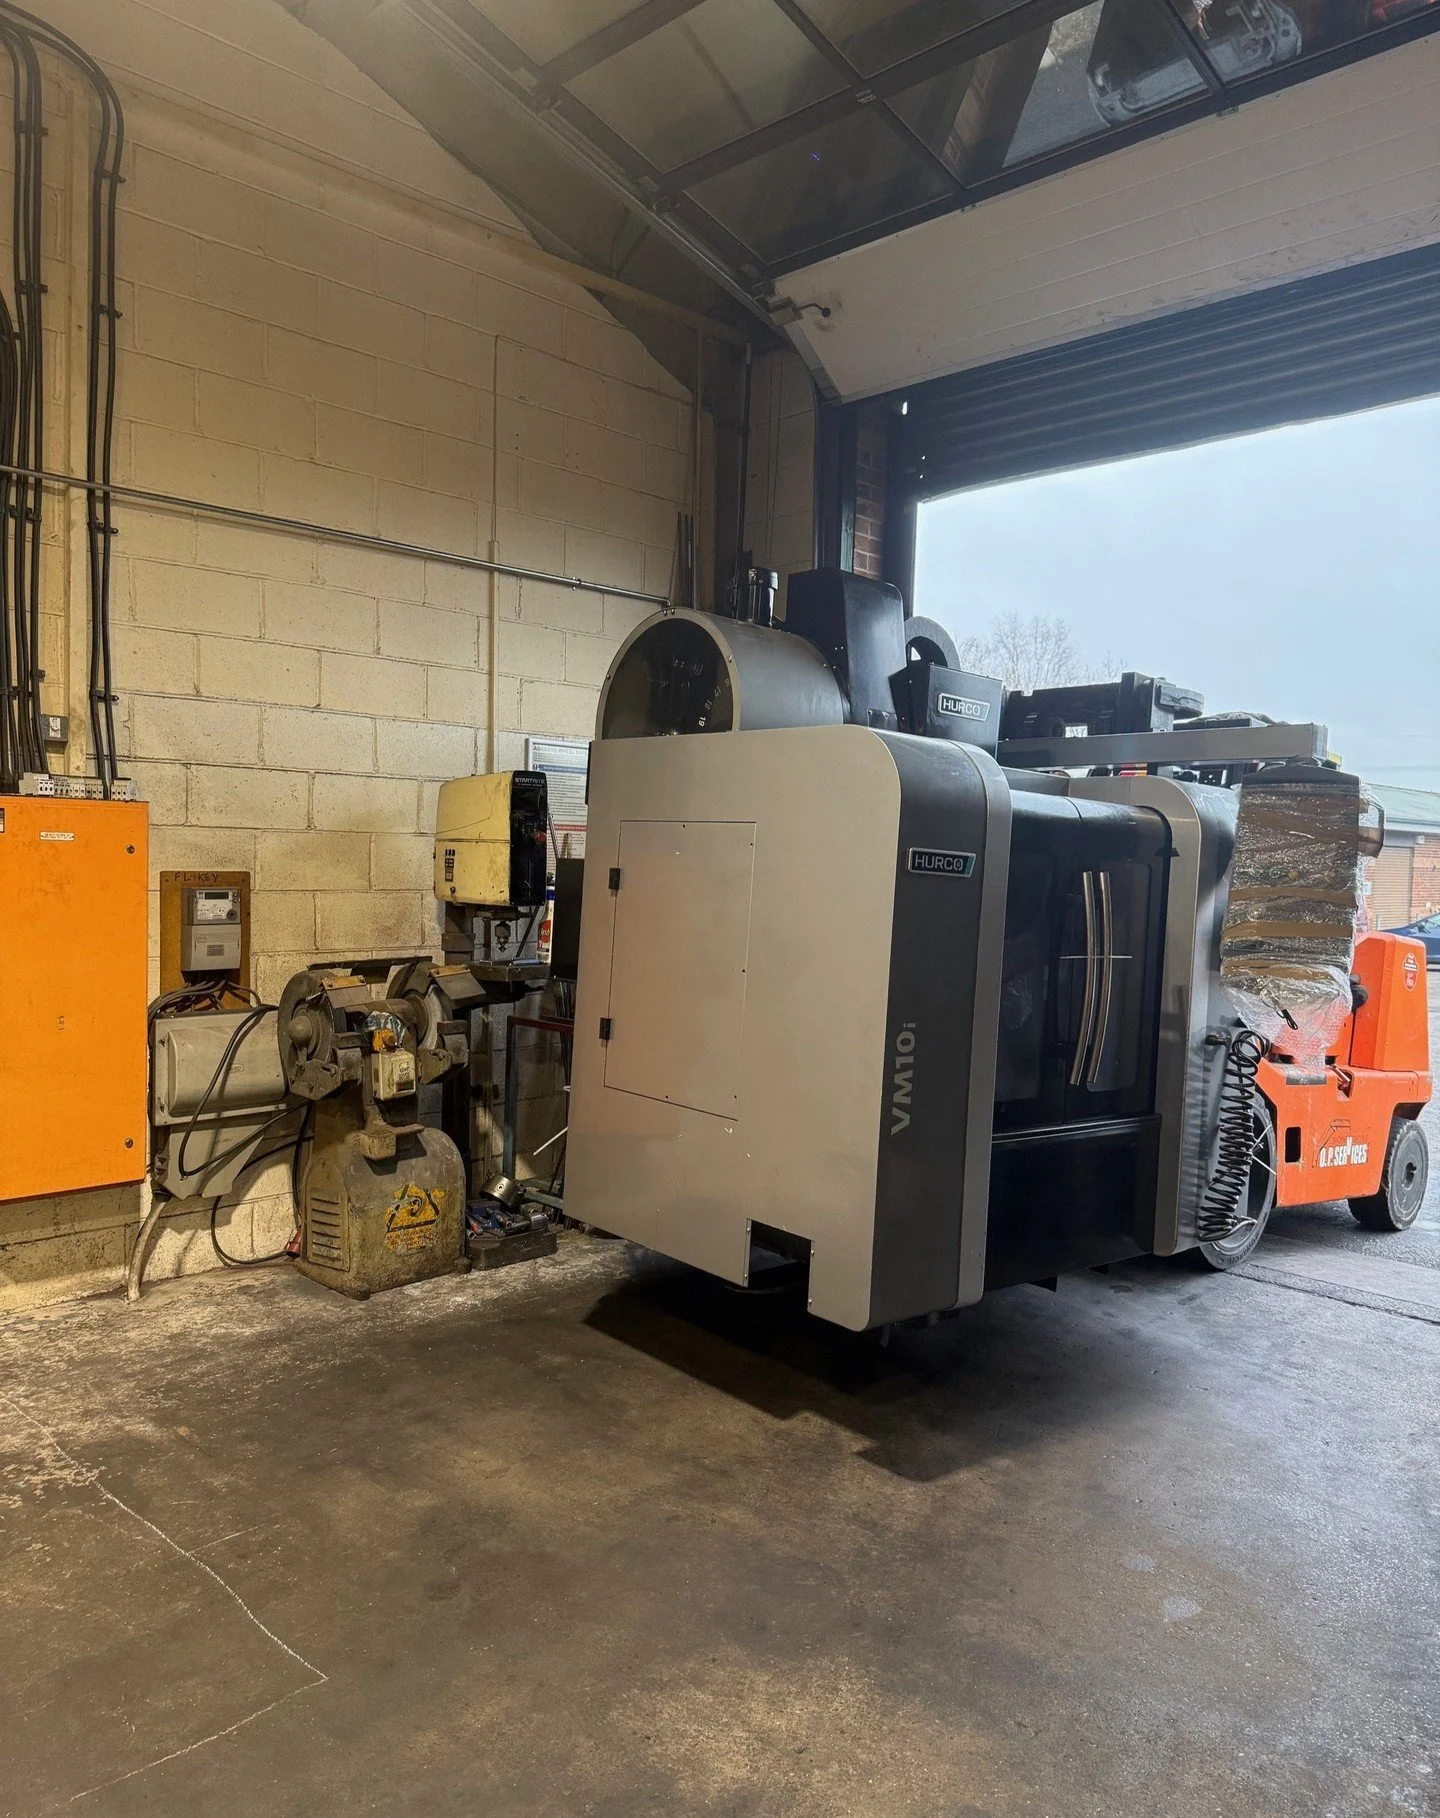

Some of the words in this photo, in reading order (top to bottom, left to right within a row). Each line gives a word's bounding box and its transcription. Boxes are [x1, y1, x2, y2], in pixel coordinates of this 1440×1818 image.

[942, 698, 981, 716] HURCO
[698, 716, 707, 727] 19
[914, 854, 964, 871] HURCO
[197, 872, 219, 884] KEY
[890, 1022, 917, 1136] VM10i
